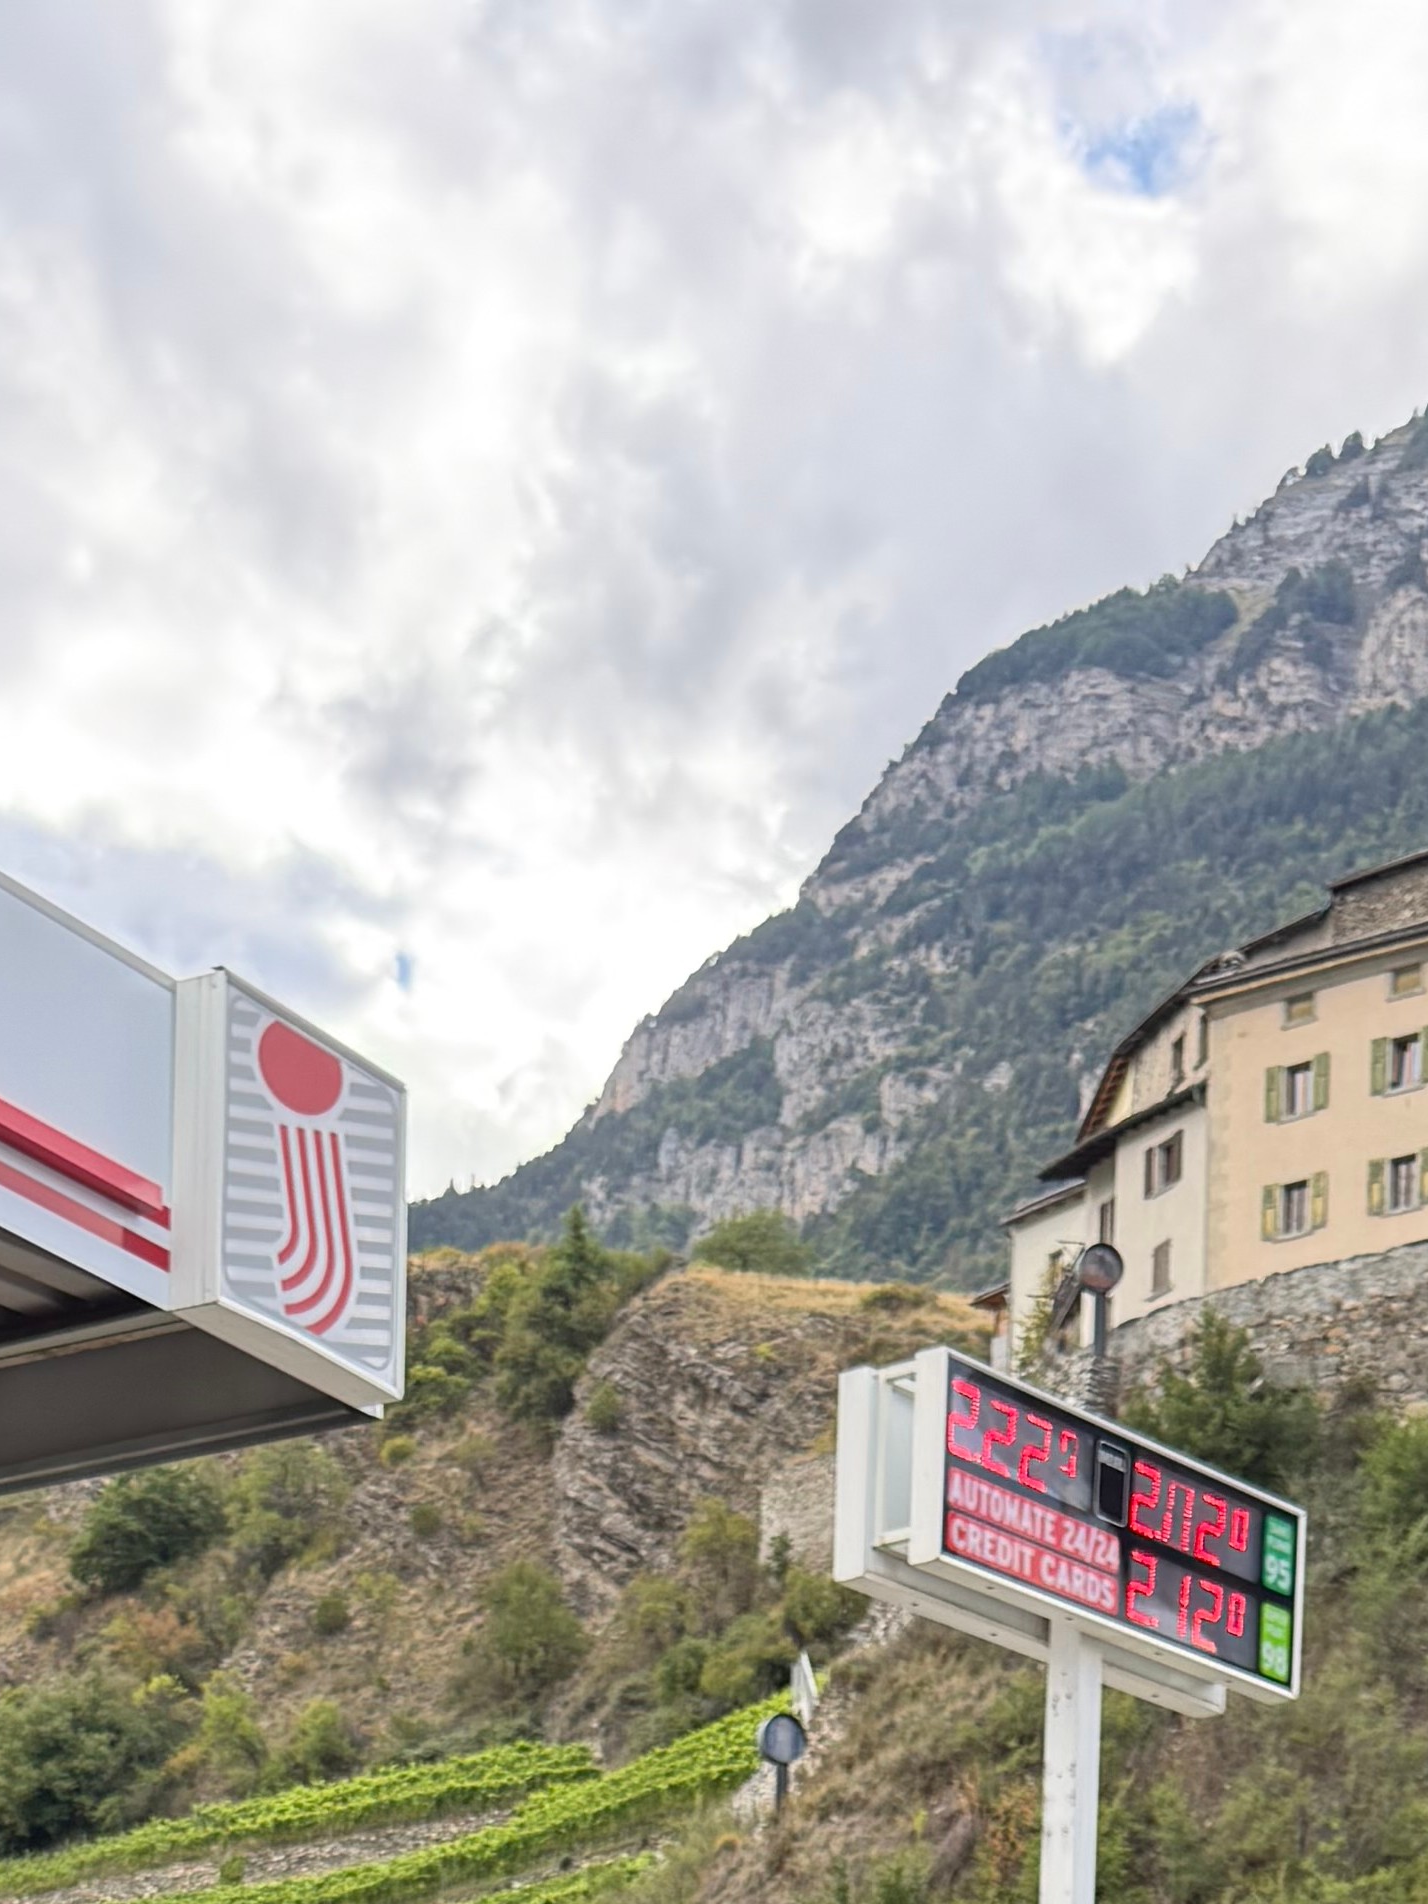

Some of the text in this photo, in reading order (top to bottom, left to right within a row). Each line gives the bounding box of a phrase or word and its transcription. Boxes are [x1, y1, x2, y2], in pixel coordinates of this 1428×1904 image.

[949, 1473, 1120, 1571] AUTOMATE 24/24
[951, 1518, 1115, 1610] CREDIT CARDS
[1264, 1554, 1292, 1591] 95
[1261, 1640, 1289, 1677] 98
